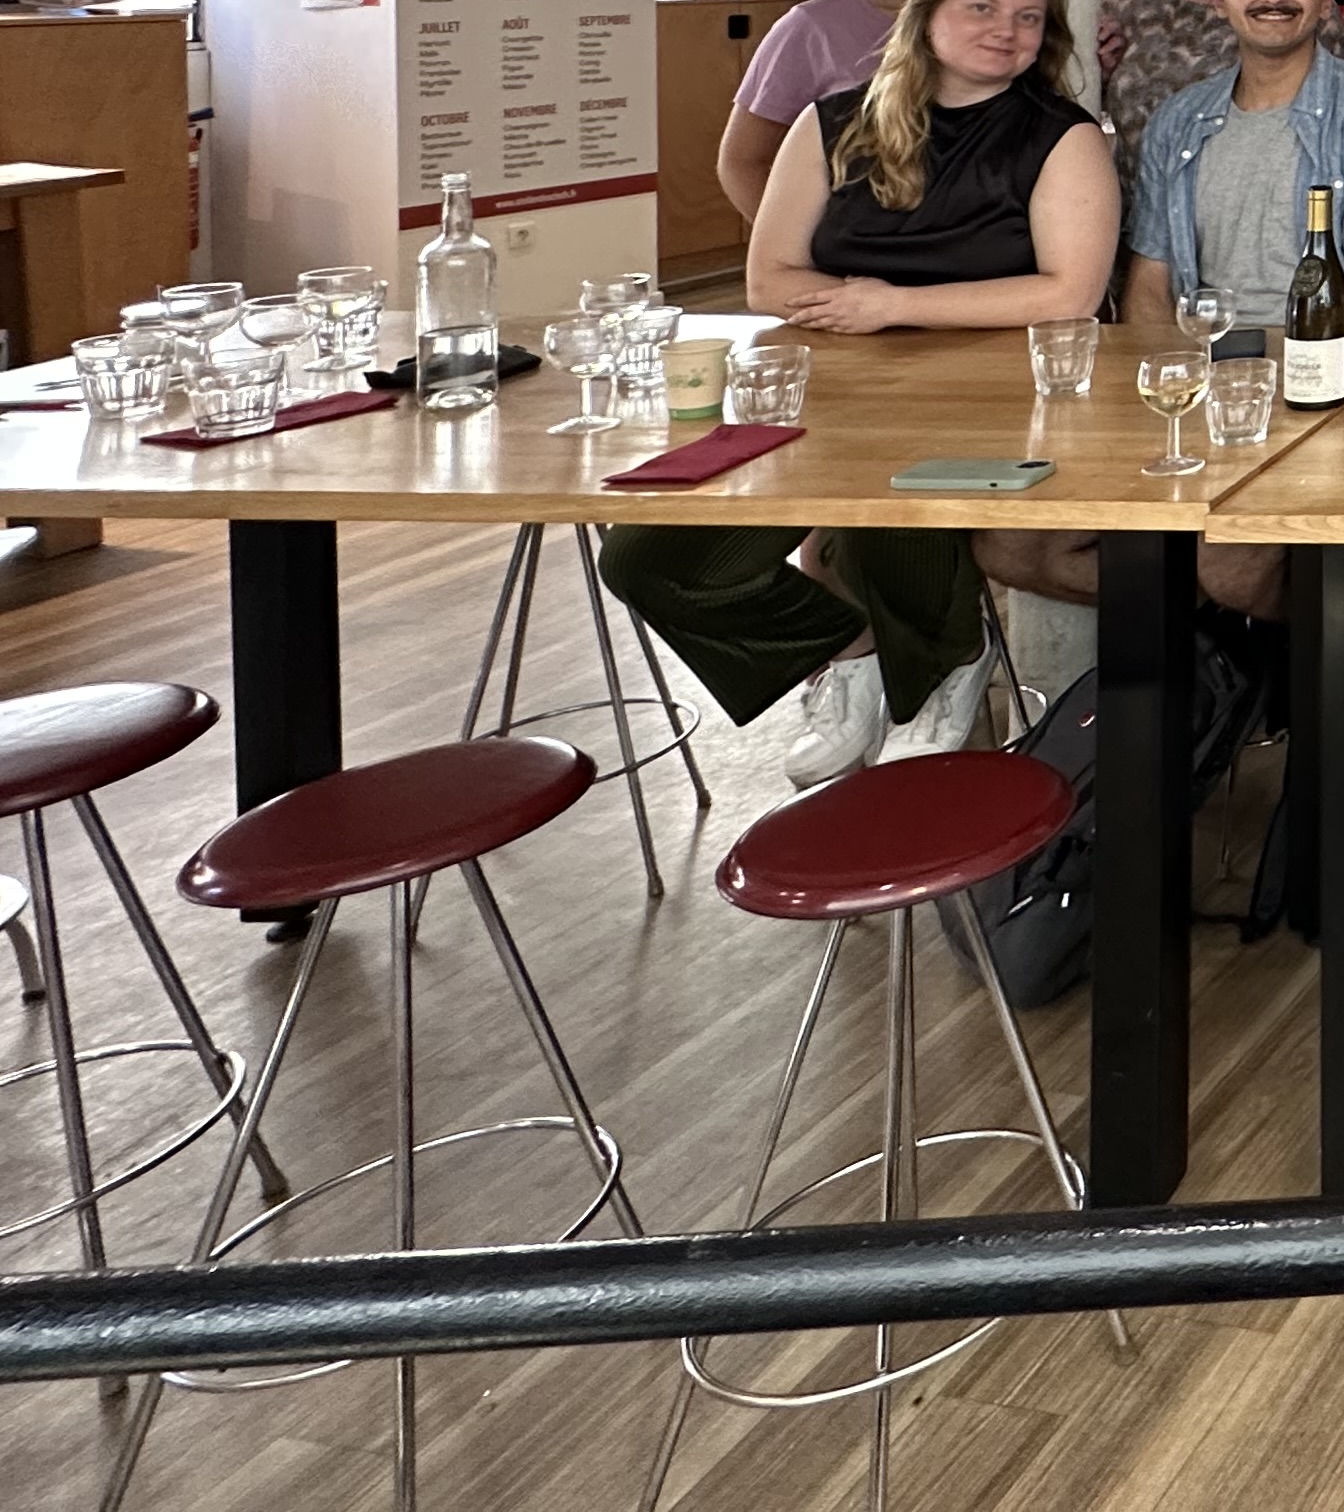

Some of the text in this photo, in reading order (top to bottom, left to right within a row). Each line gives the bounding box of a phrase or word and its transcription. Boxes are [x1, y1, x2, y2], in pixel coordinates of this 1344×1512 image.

[419, 21, 461, 34] JUILLET
[501, 15, 529, 30] AOÛT
[579, 14, 631, 27] SEPTEMBRE
[503, 103, 557, 118] NOVEMBRE
[579, 96, 627, 112] DÉCEMBRE
[421, 111, 470, 127] OCTOBRE
